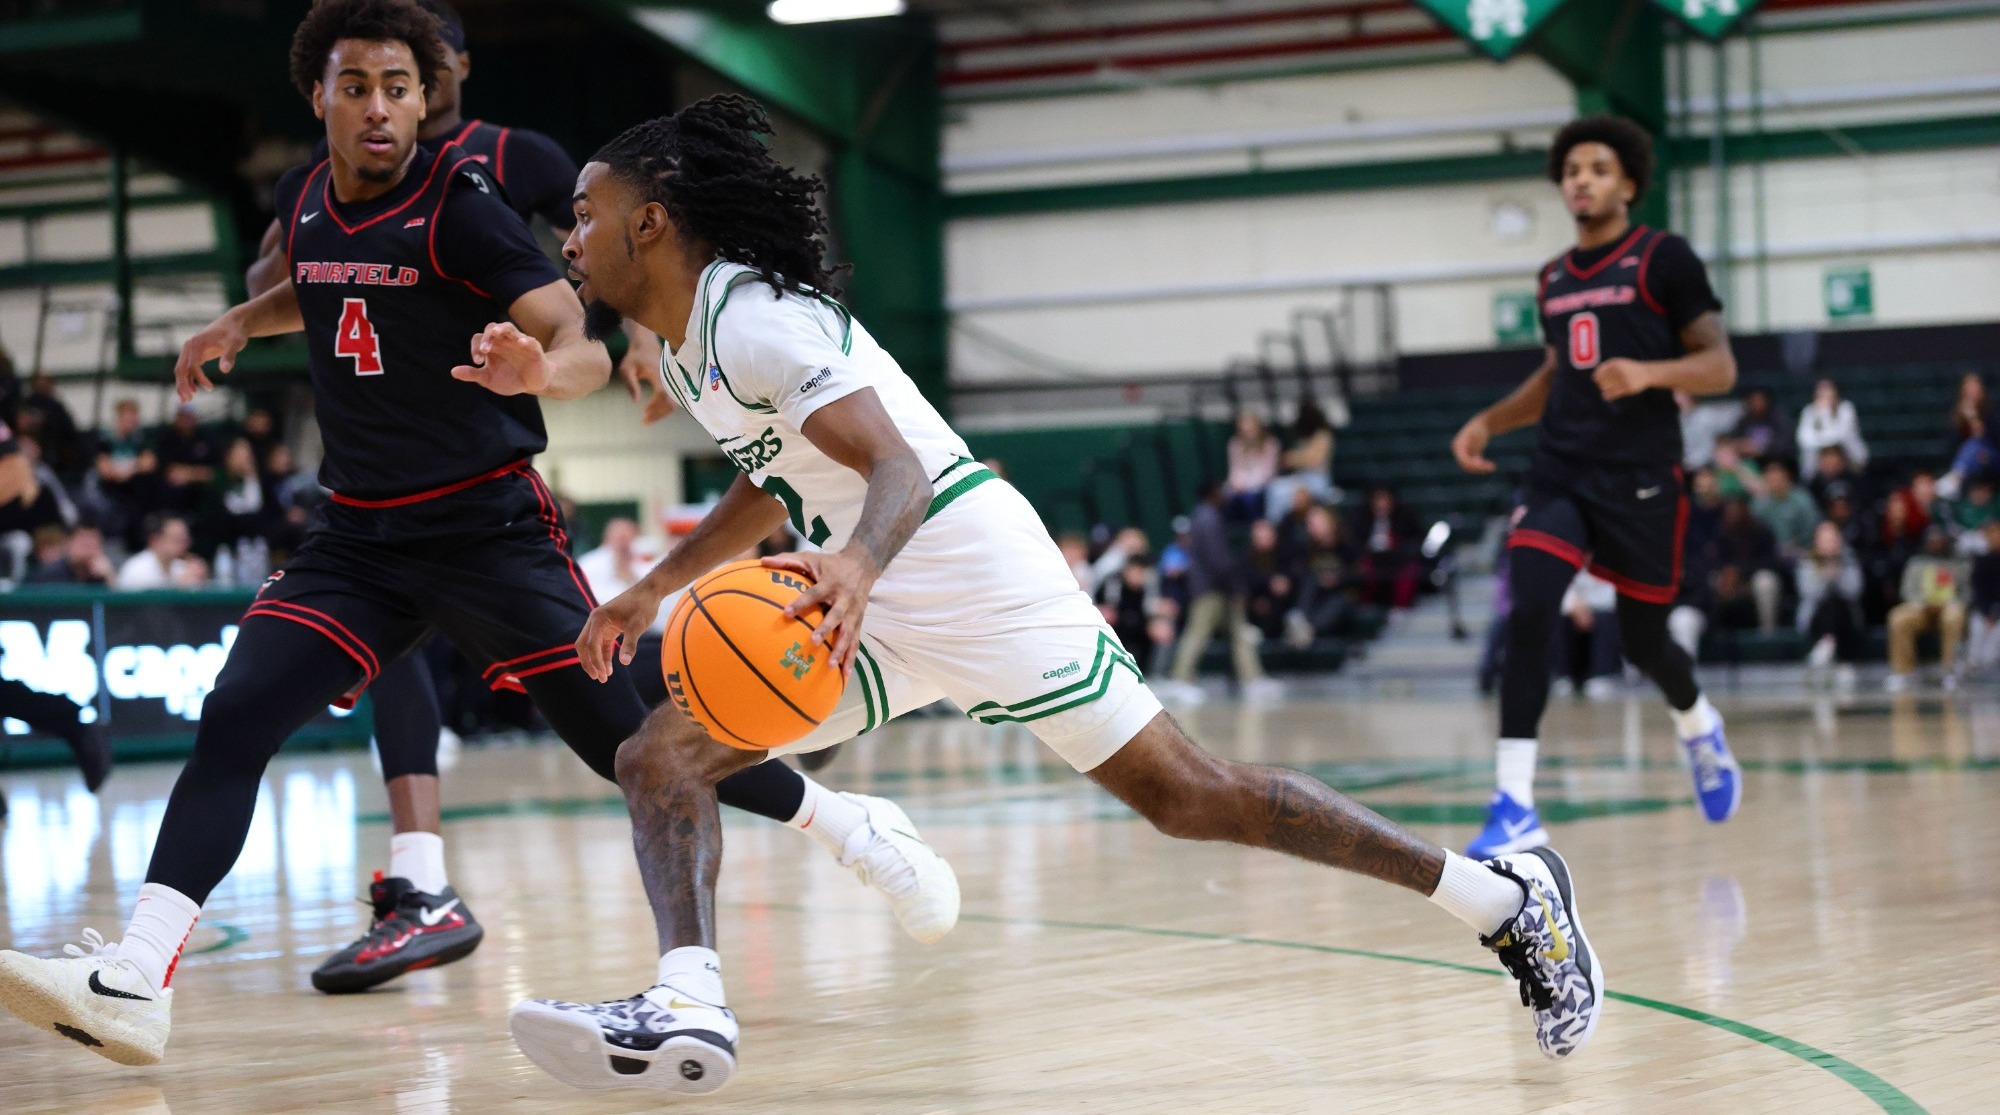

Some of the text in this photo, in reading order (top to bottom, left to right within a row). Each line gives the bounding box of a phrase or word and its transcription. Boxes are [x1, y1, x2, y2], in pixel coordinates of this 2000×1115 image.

[297, 262, 419, 286] FAIRFIELD
[335, 298, 384, 376] 4
[1569, 312, 1600, 369] 0
[800, 367, 832, 393] capelli
[761, 475, 832, 548] 2
[1042, 660, 1081, 680] capelli
